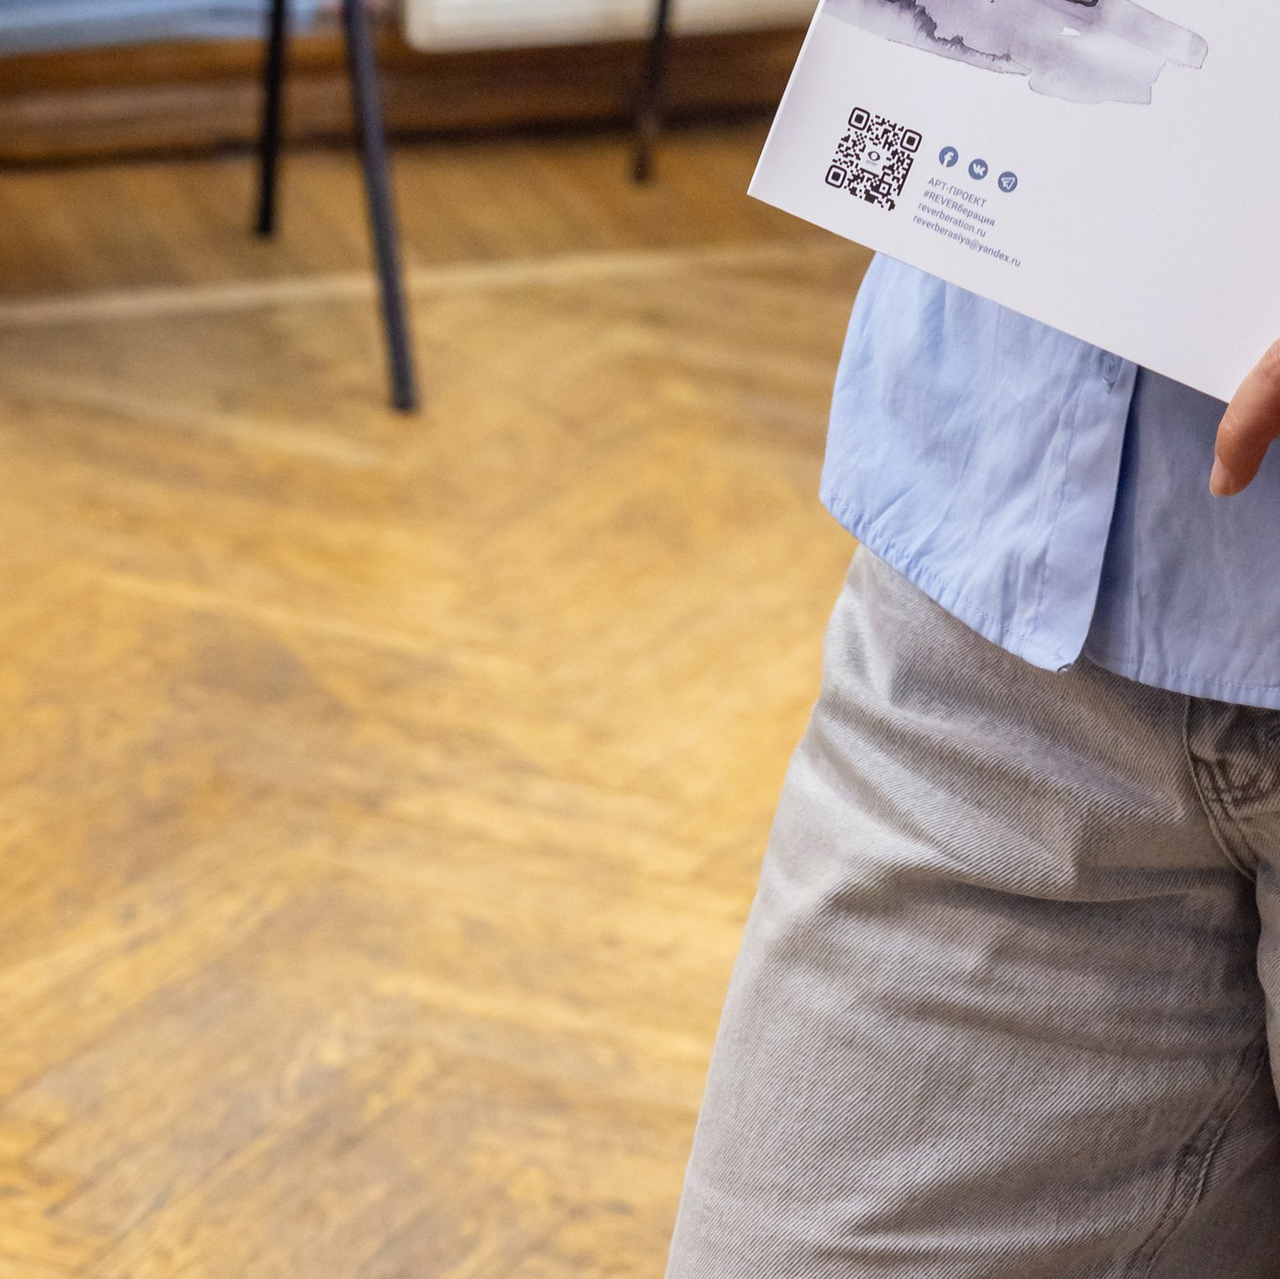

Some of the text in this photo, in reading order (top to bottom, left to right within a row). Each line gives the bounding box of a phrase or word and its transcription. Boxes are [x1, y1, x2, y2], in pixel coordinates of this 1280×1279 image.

[923, 190, 996, 227] #REVERберация
[927, 177, 987, 208] АРТ-ПРОЕКТ
[917, 203, 987, 238] reverberation.ru
